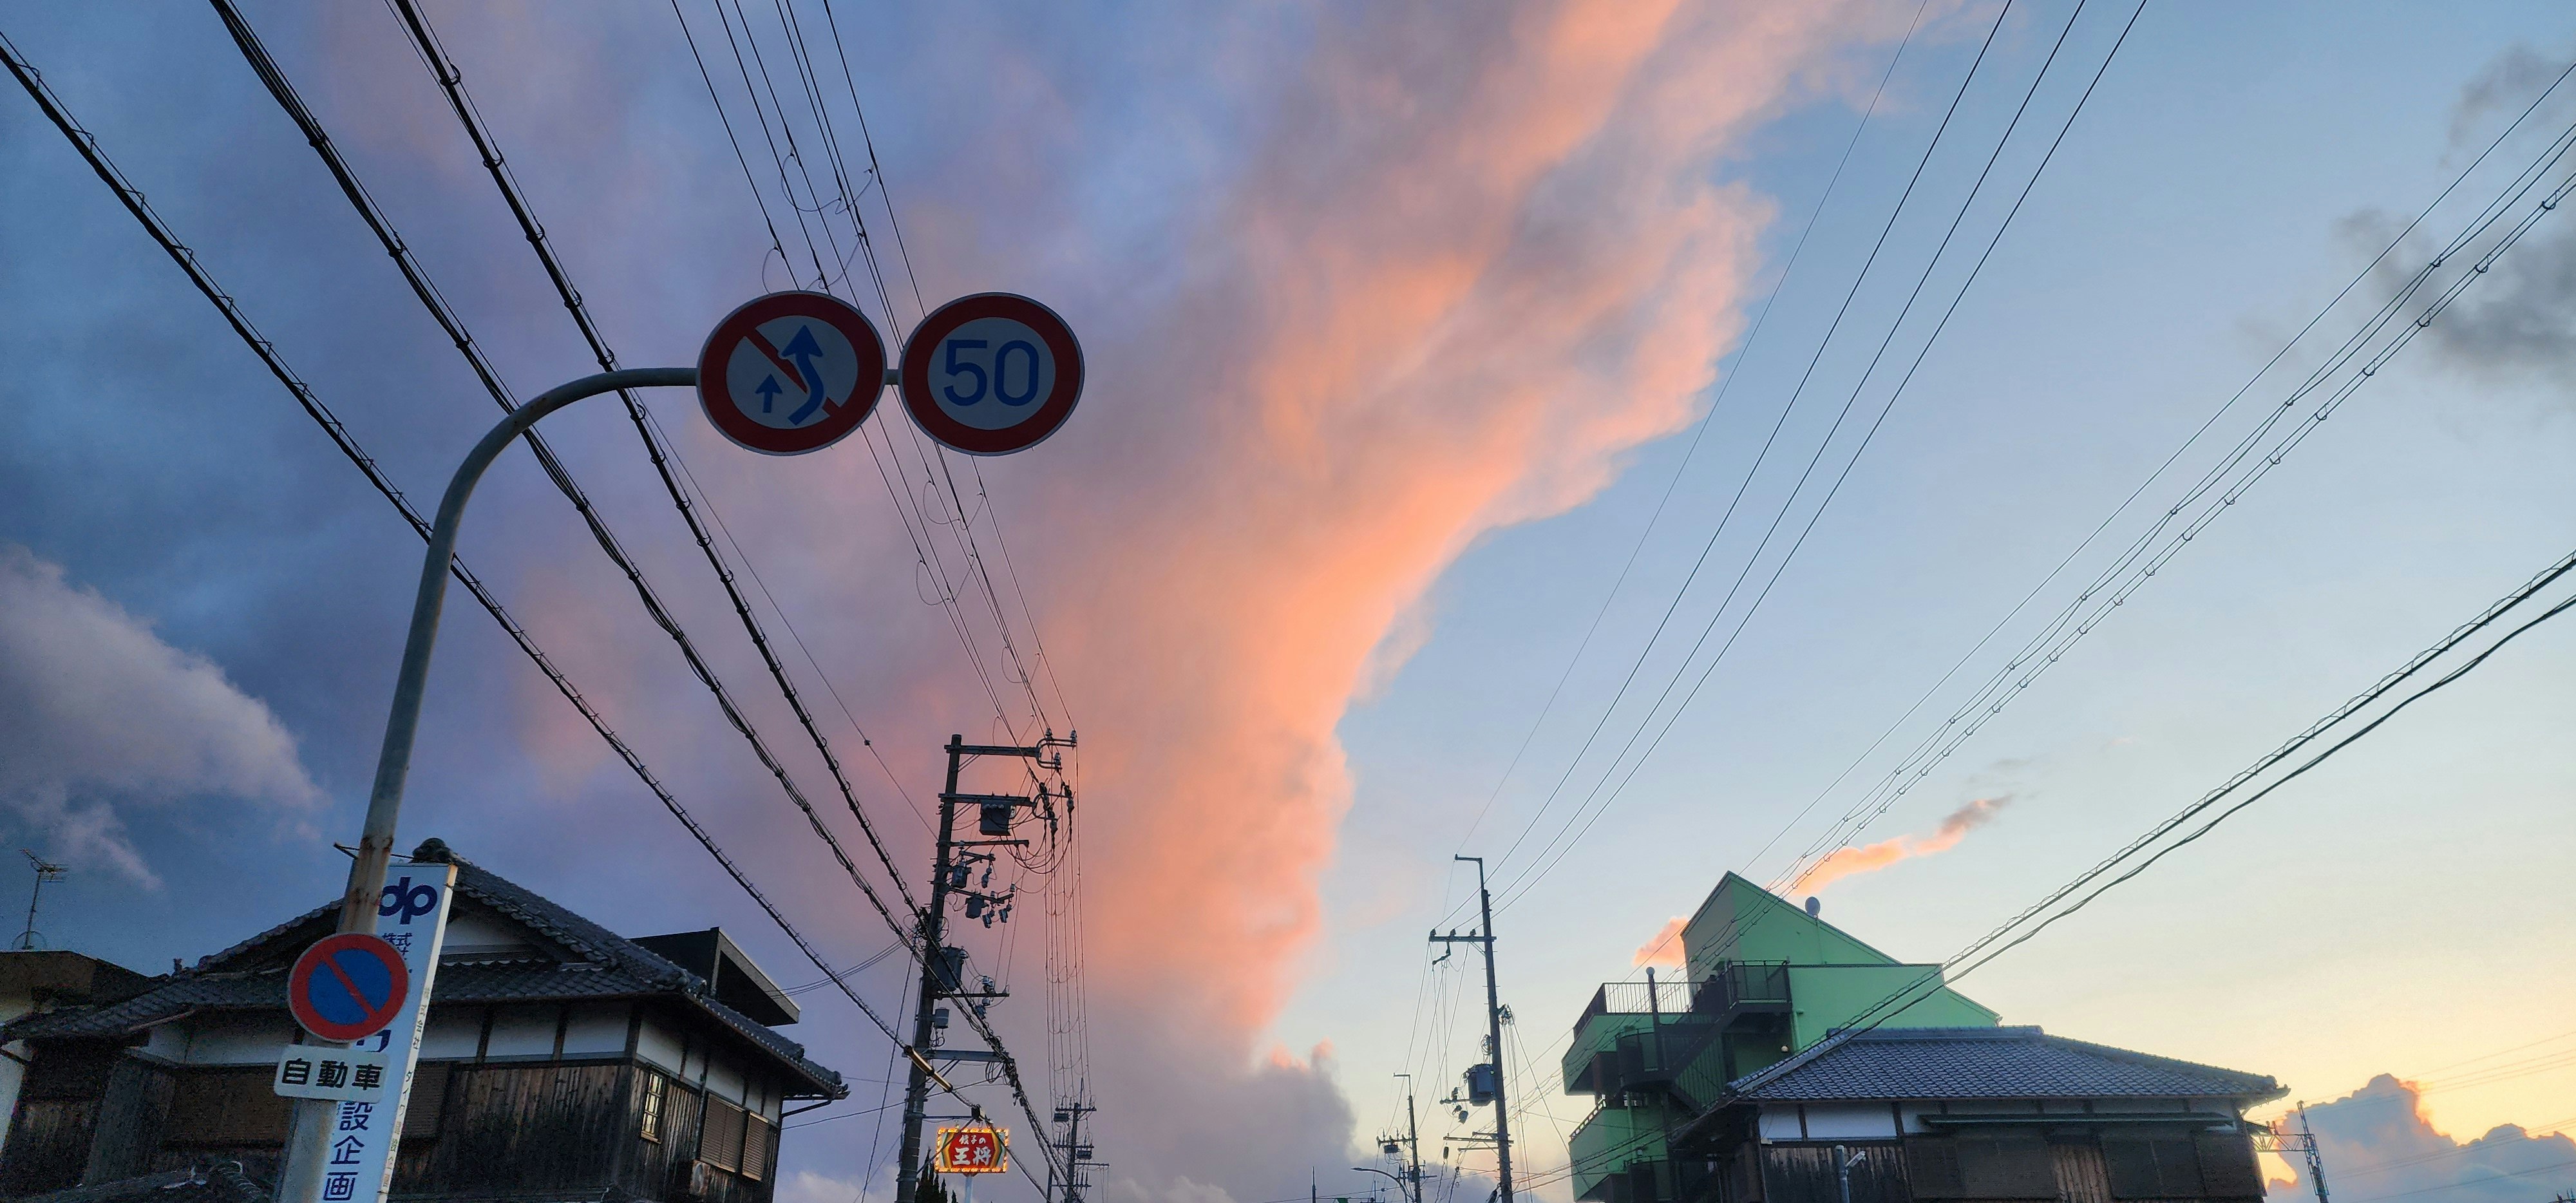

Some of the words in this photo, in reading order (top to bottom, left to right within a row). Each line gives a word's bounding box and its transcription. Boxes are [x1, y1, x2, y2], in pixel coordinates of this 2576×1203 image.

[944, 339, 1039, 406] 50
[281, 1057, 383, 1090] 自動車
[959, 1134, 987, 1145] 餃子の
[952, 1146, 992, 1166] 王将
